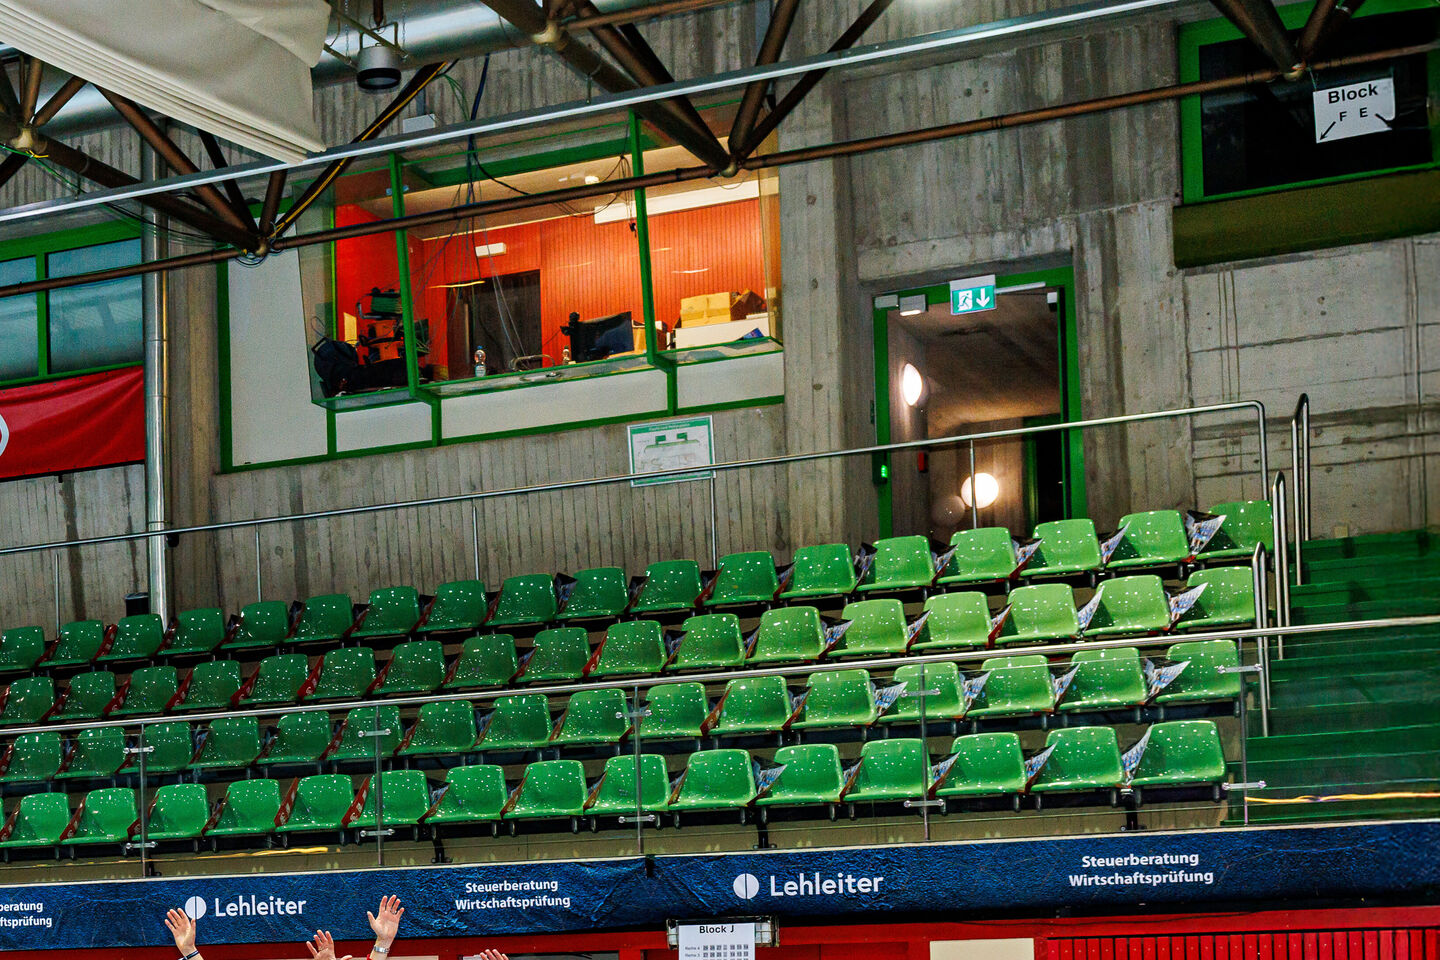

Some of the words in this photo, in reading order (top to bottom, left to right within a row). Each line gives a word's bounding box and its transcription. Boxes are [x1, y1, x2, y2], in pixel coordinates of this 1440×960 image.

[1328, 83, 1378, 104] Block
[1339, 111, 1347, 121] F
[1359, 107, 1368, 118] E
[1081, 853, 1199, 868] Steuerberatung
[770, 872, 883, 897] Lehleiter
[1068, 870, 1214, 886] Wirtschaftsprüfung
[465, 880, 558, 893] Steuerberatung
[214, 894, 307, 917] Lehleiter
[455, 895, 571, 910] Wirtschaftsprüfung
[699, 925, 727, 934] Block
[730, 925, 735, 933] J
